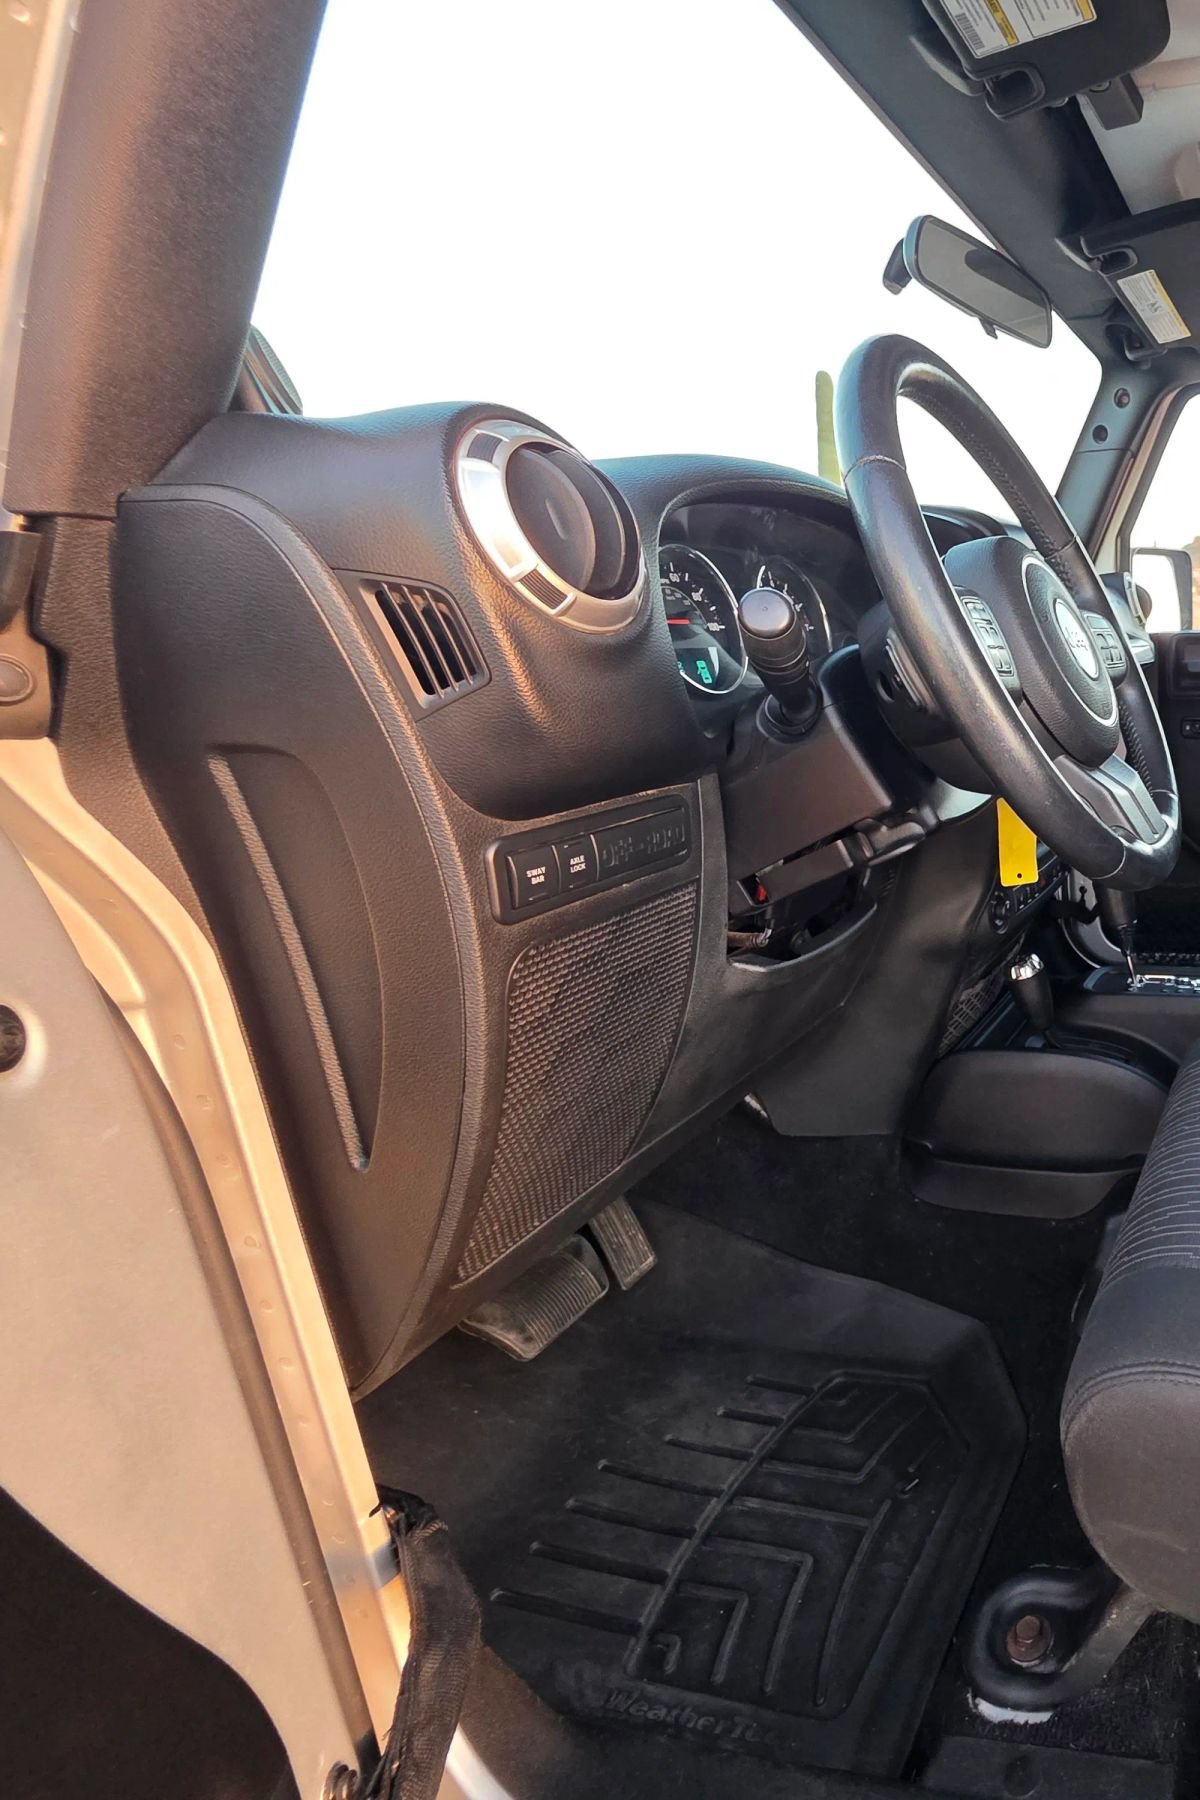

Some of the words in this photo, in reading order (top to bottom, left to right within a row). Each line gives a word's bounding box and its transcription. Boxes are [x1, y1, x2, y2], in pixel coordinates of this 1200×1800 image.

[570, 855, 585, 866] AXLE
[526, 866, 546, 878] SWAY
[570, 863, 586, 873] LOCK
[531, 875, 545, 885] BAR
